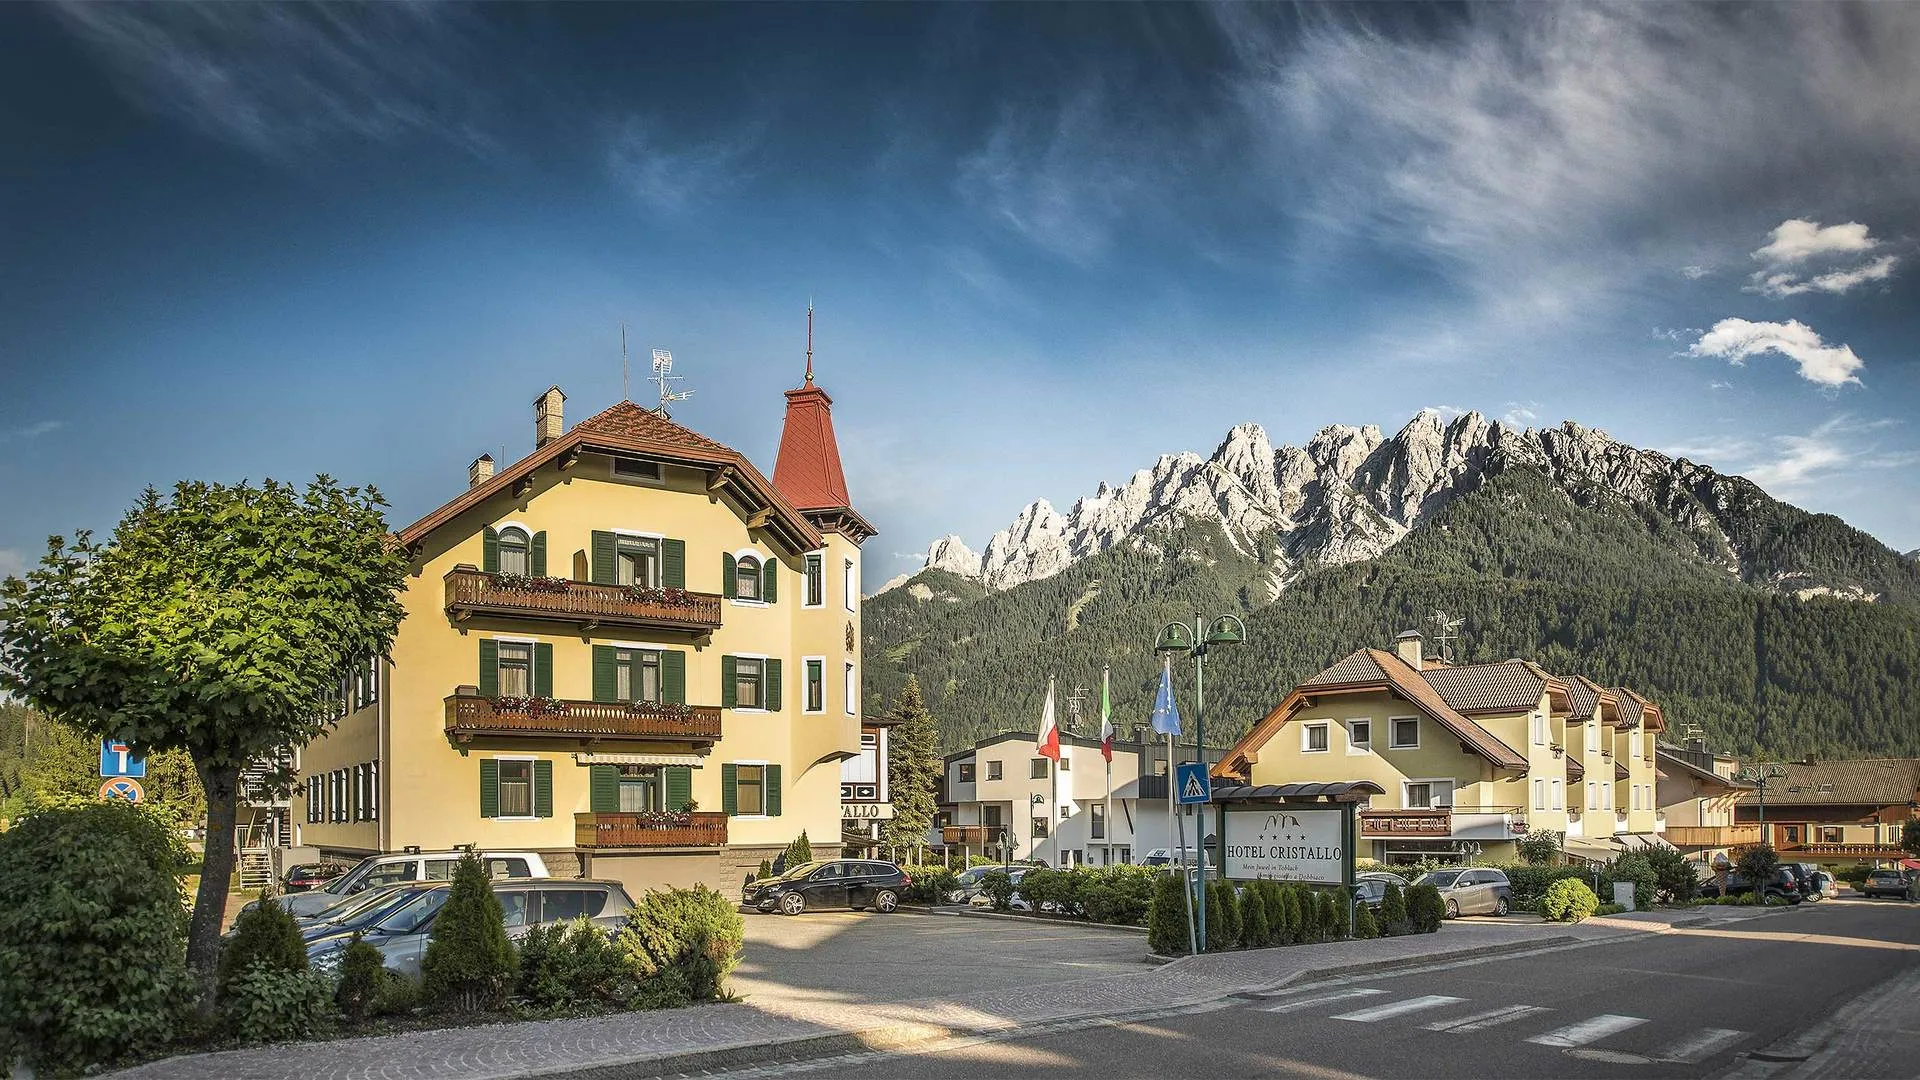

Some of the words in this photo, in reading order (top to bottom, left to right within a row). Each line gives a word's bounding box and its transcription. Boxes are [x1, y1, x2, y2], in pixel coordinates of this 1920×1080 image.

[841, 804, 879, 818] ALLO
[1227, 845, 1266, 859] HOTEL
[1270, 846, 1342, 861] CRISTALLO
[1278, 864, 1298, 872] Toblach
